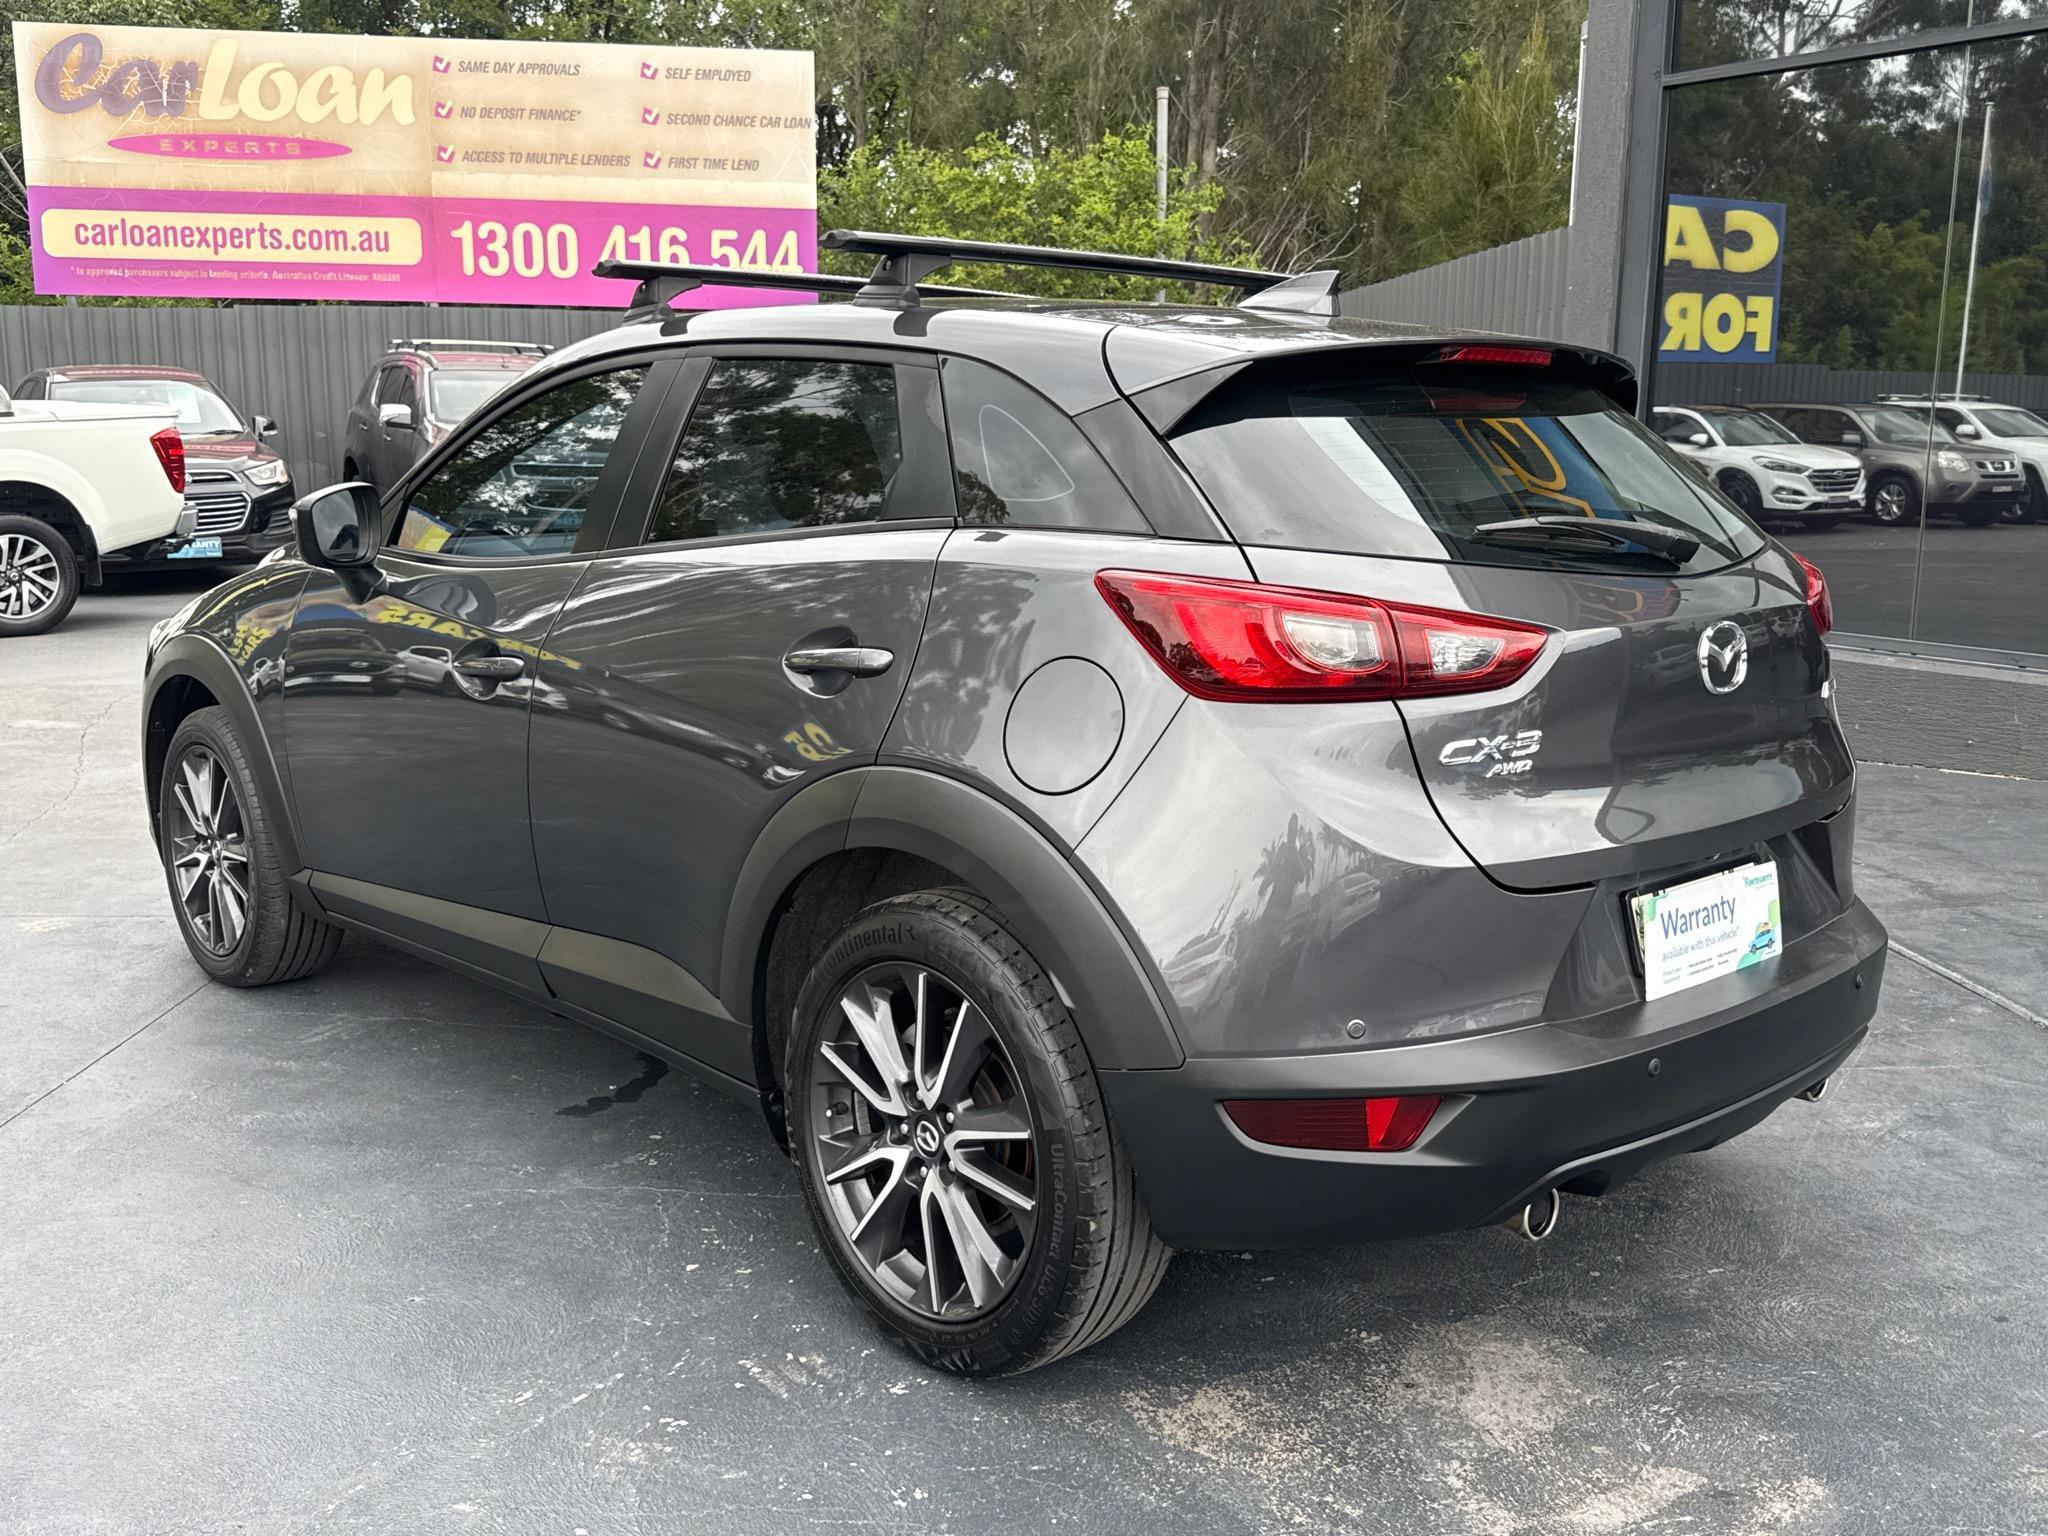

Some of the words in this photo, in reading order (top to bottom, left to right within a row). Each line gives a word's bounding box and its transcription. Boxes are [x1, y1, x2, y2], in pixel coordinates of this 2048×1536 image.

[458, 60, 490, 73] SAME
[493, 61, 515, 74] DAY
[517, 62, 581, 76] APPROVALS
[665, 67, 692, 80] SELF
[695, 69, 751, 82] EMPLOYED
[460, 106, 477, 118] NO
[479, 107, 526, 120] DEPOSIT
[666, 112, 710, 126] SECOND
[713, 114, 757, 128] CHANCE
[760, 115, 781, 128] CAR
[784, 117, 812, 130] LOAN
[158, 139, 301, 155] EXPERTS
[462, 150, 505, 164] ACCESS
[509, 152, 522, 164] TO
[525, 152, 580, 166] MULTIPLE
[581, 153, 631, 167] LENDERS
[668, 156, 699, 169] FIRST
[702, 157, 729, 170] TIME
[731, 158, 760, 171] LEND
[74, 218, 390, 256] carloanexperts.com.au
[450, 220, 579, 279] 1300
[599, 224, 690, 265] 416
[710, 229, 804, 274] 544
[1439, 730, 1542, 766] CX-3
[1485, 759, 1533, 778] AWD
[1660, 896, 1736, 940] Warranty
[1662, 943, 1689, 961] available
[1690, 939, 1705, 950] with
[1705, 936, 1717, 946] this
[1049, 1142, 1068, 1258] UltraContact
